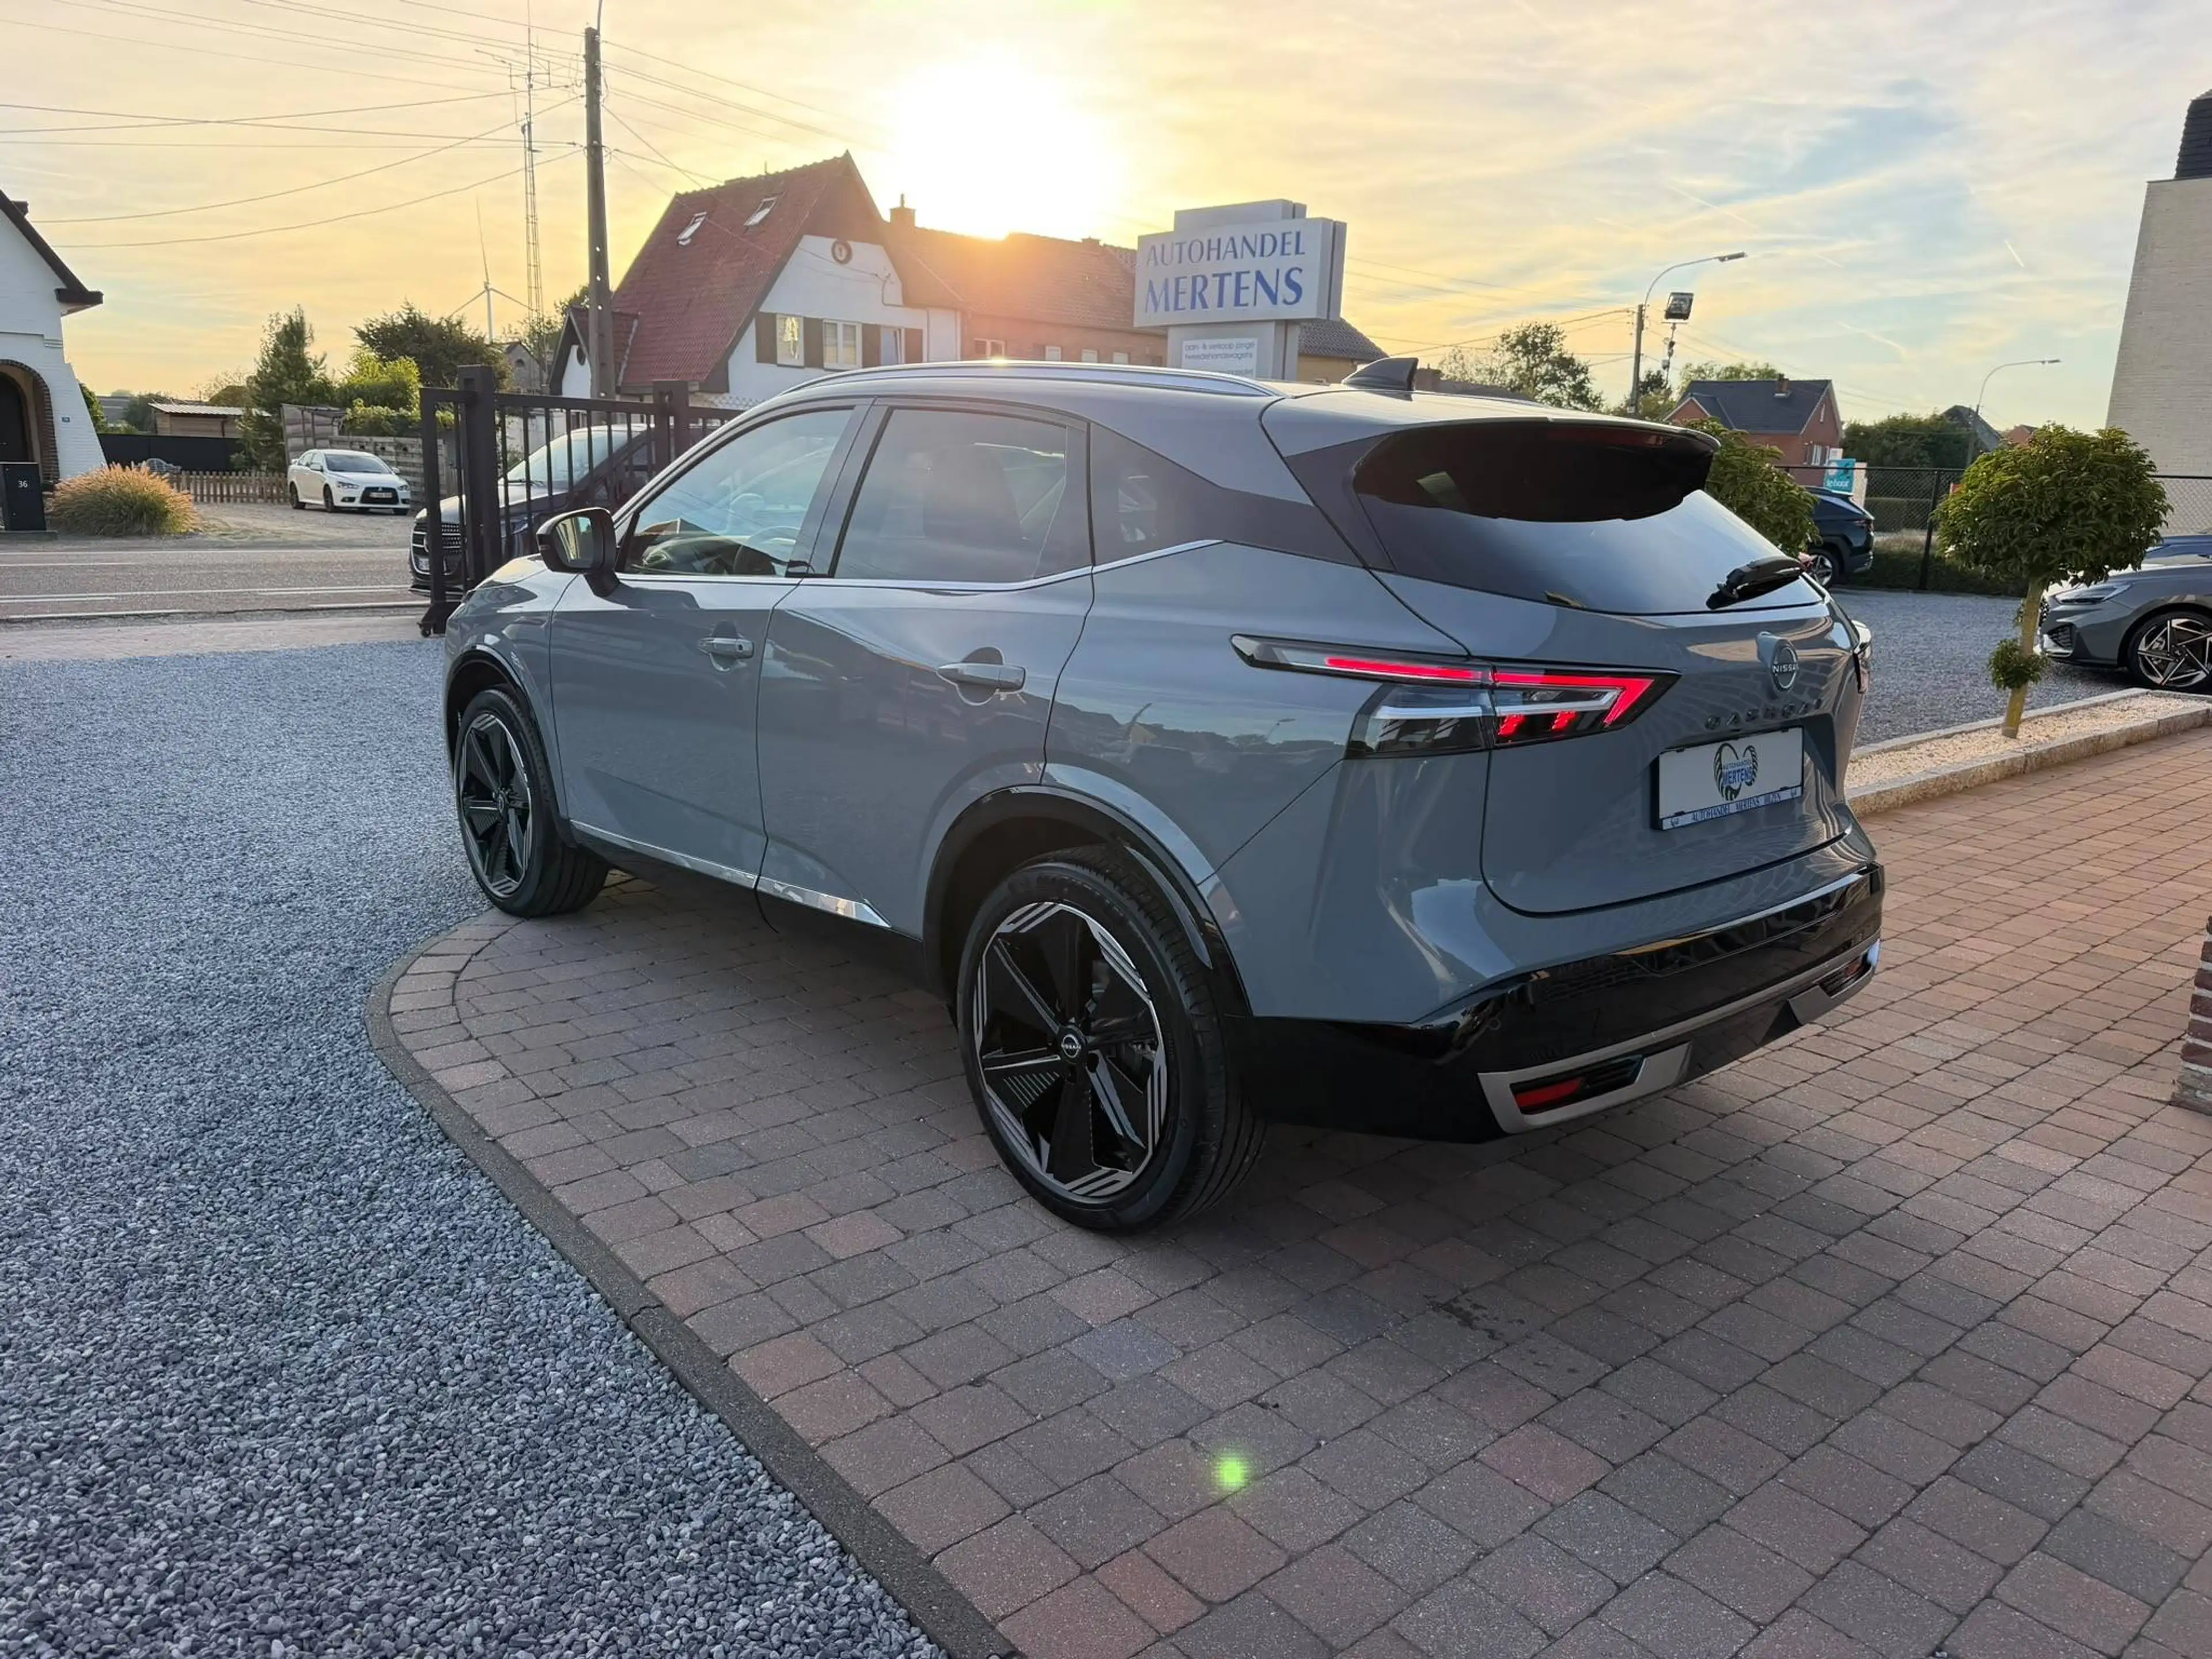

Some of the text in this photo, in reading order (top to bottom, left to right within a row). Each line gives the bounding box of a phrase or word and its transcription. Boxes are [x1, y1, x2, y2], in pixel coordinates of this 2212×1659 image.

[1146, 230, 1305, 267] AUTOHANDEL
[1145, 267, 1304, 314] MERTENS
[18, 480, 28, 488] 36
